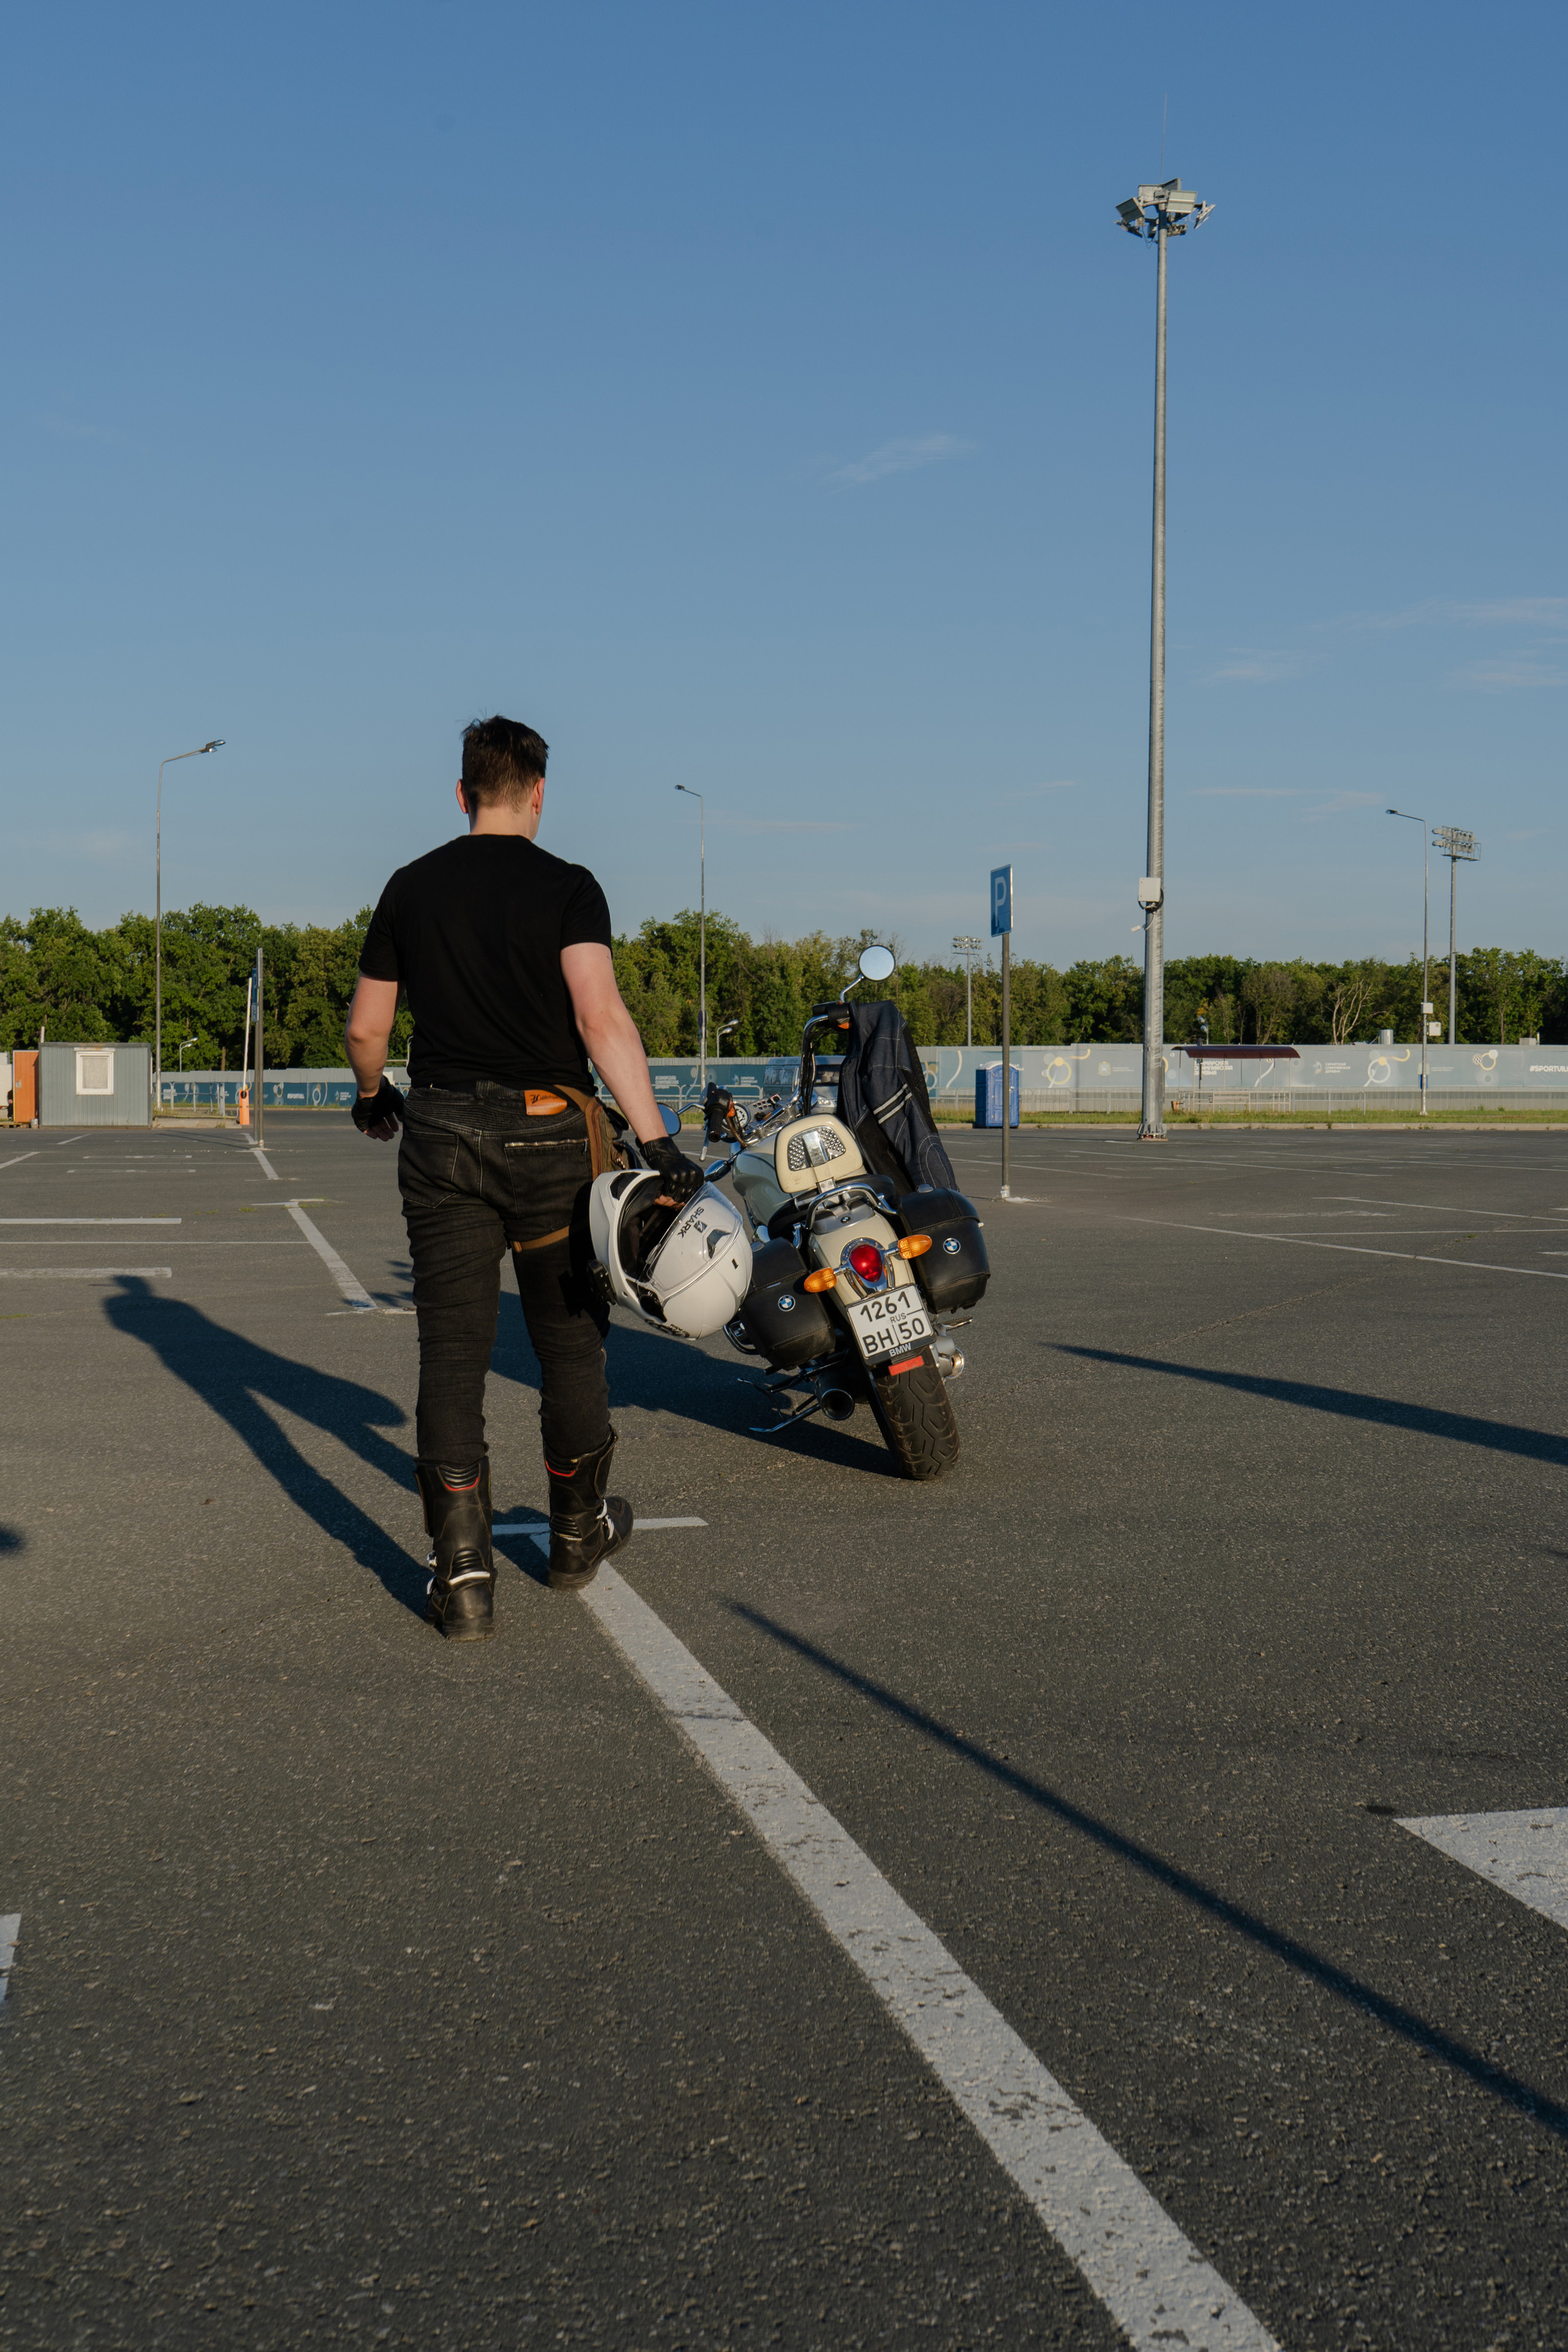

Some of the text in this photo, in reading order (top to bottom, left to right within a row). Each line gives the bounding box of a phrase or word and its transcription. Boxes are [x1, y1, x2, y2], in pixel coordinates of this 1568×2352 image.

[995, 876, 1006, 927] P
[677, 1207, 704, 1238] SHARK
[861, 1291, 910, 1322] 1261
[890, 1313, 907, 1324] RUS
[898, 1317, 924, 1340] 50
[889, 1343, 911, 1357] BMW
